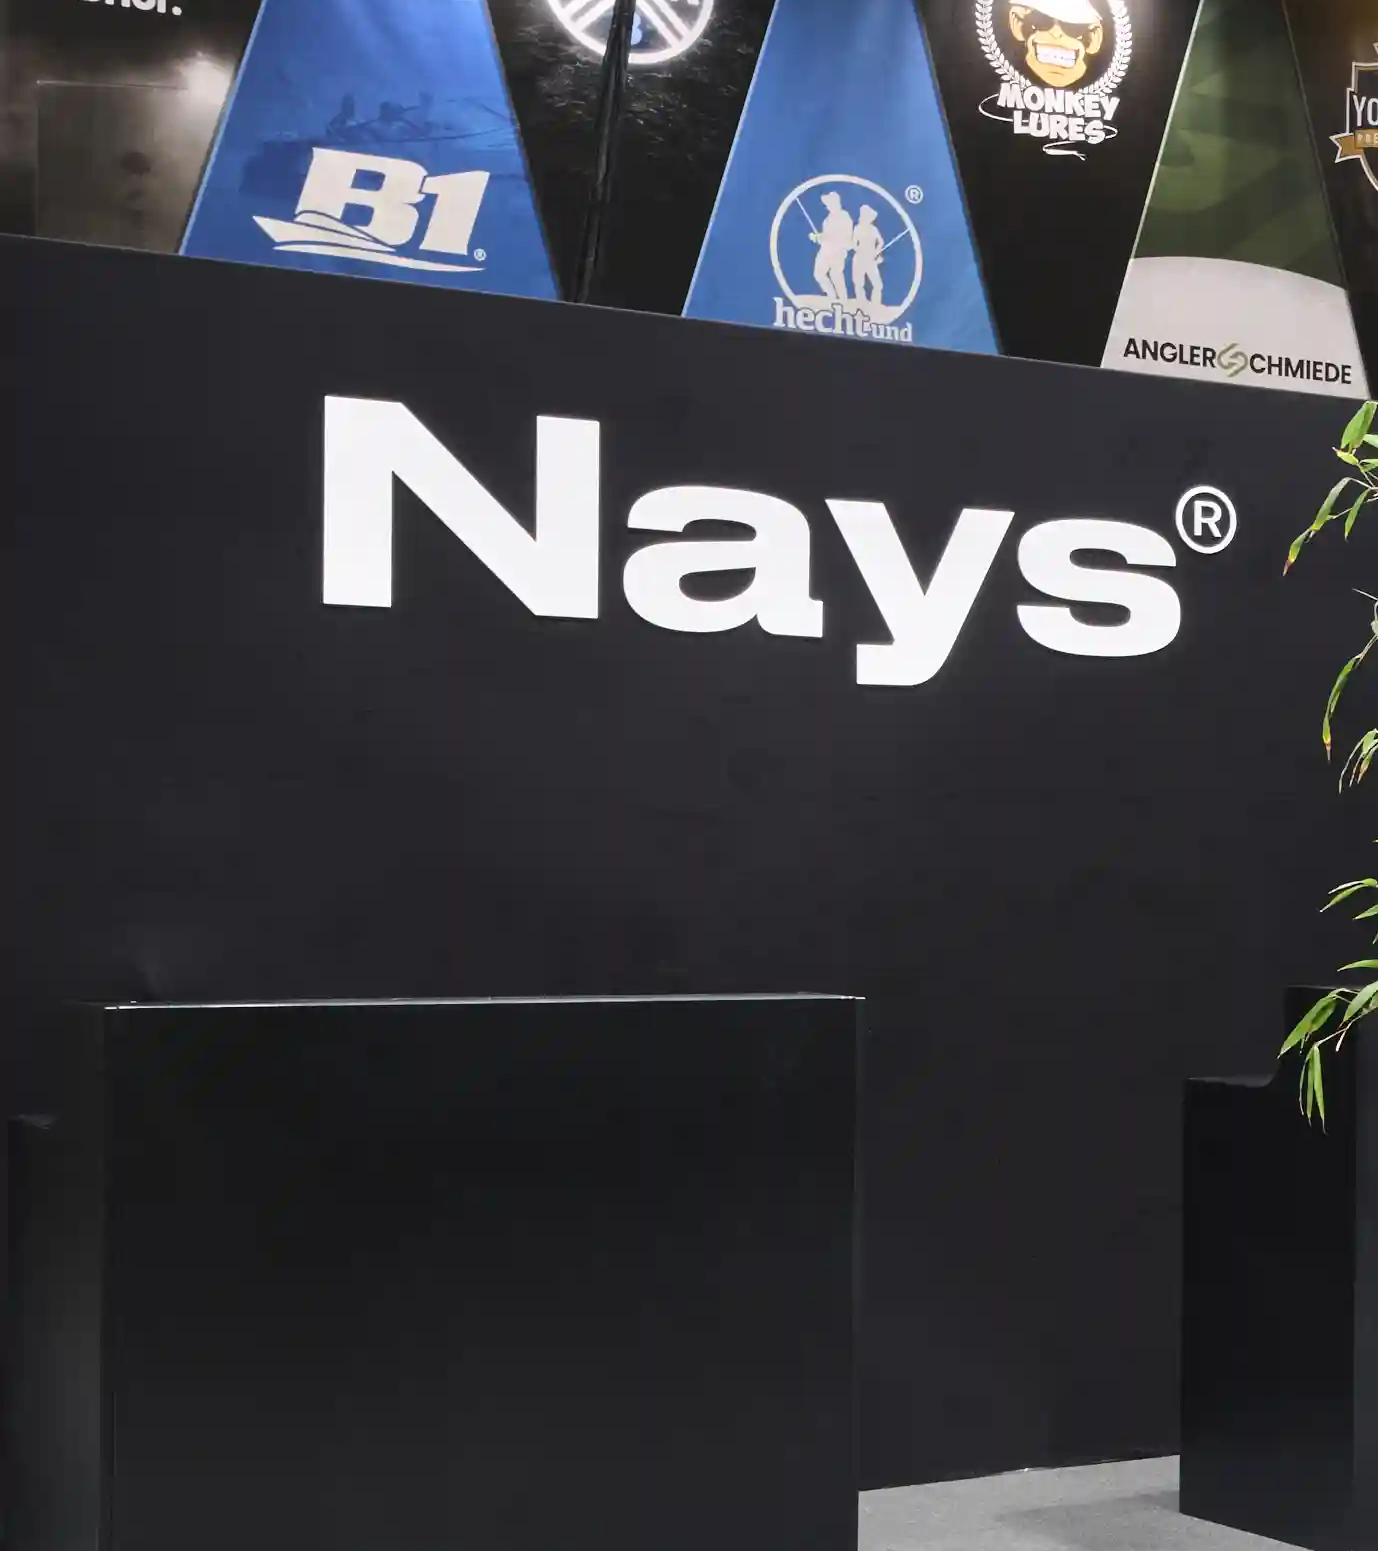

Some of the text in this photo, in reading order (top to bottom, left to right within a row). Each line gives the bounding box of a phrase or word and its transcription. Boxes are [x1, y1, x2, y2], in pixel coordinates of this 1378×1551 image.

[997, 83, 1121, 121] MONKEY
[1013, 110, 1106, 145] LURES
[773, 297, 913, 342] hecht und
